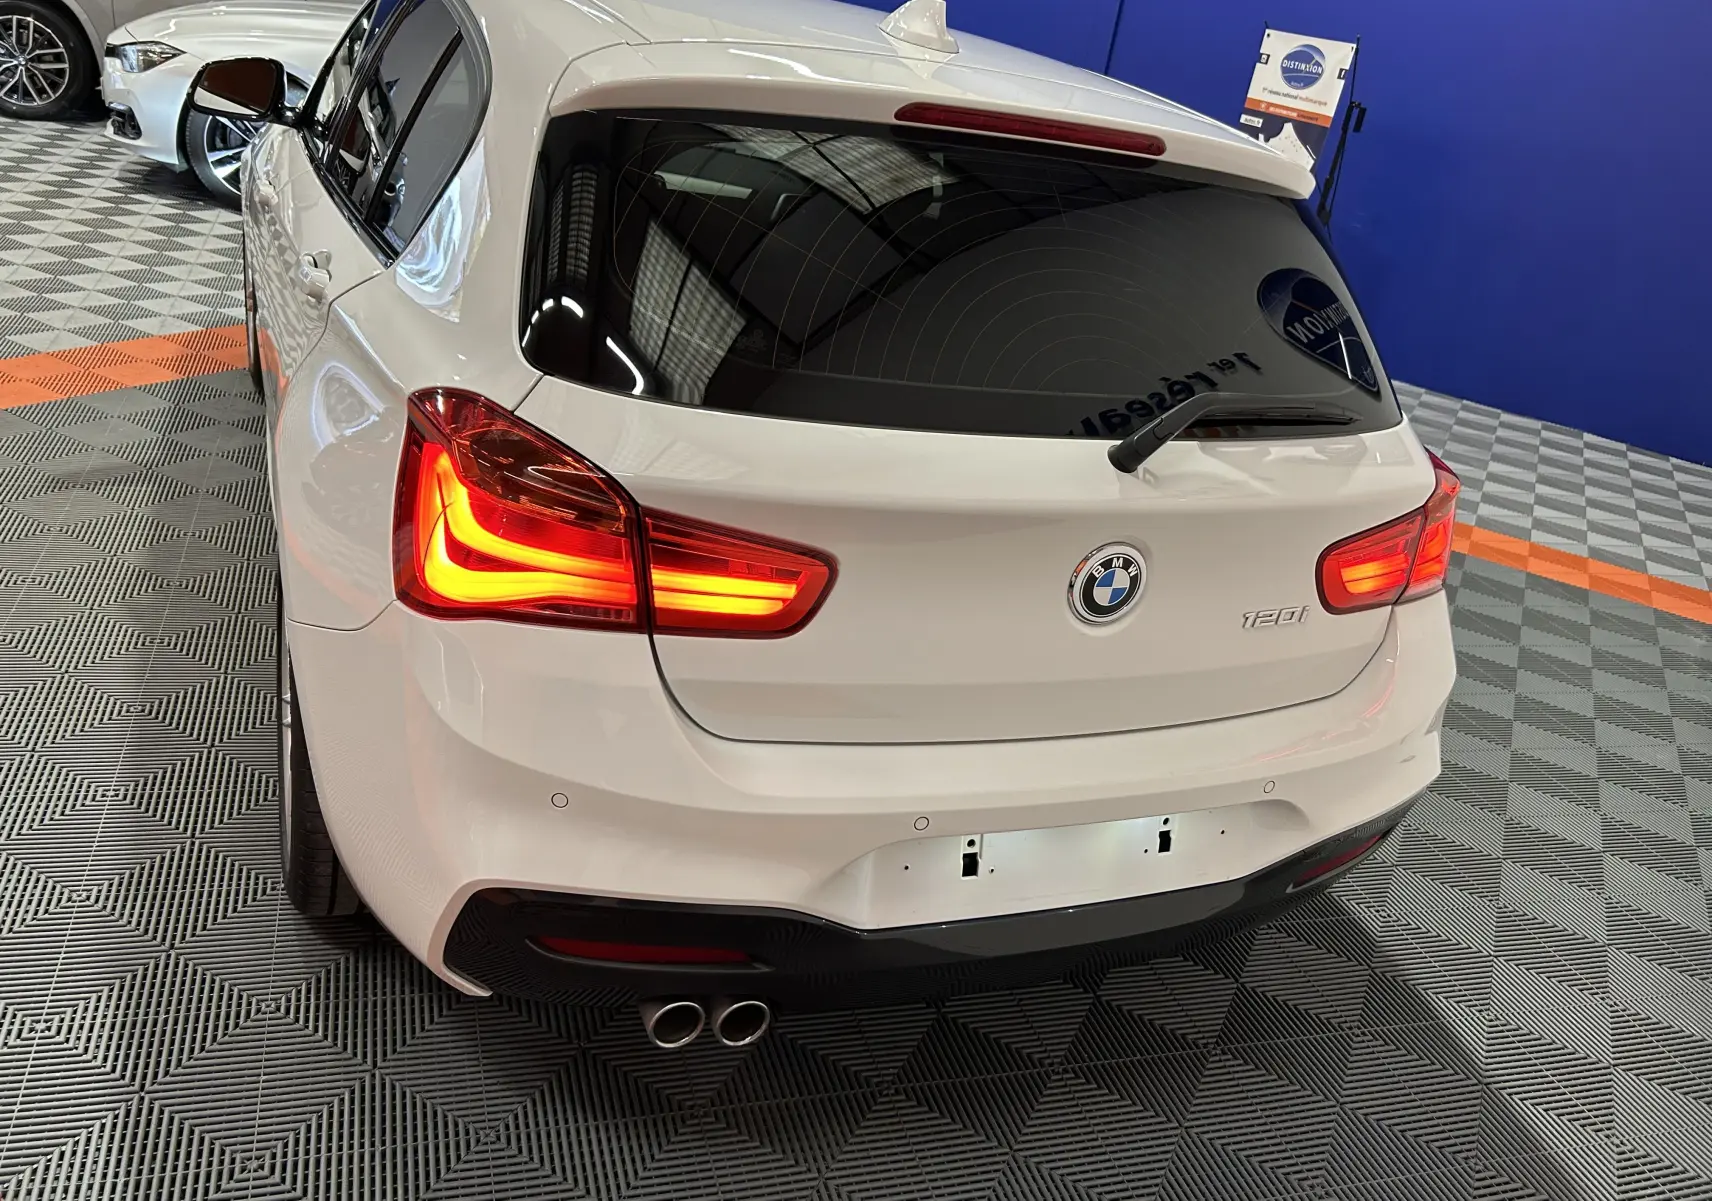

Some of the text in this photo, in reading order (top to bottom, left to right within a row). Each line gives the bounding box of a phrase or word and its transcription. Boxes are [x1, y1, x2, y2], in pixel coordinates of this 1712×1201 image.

[1282, 59, 1323, 74] DISTINXION
[1092, 557, 1138, 578] BMW
[1242, 605, 1310, 628] 120i
